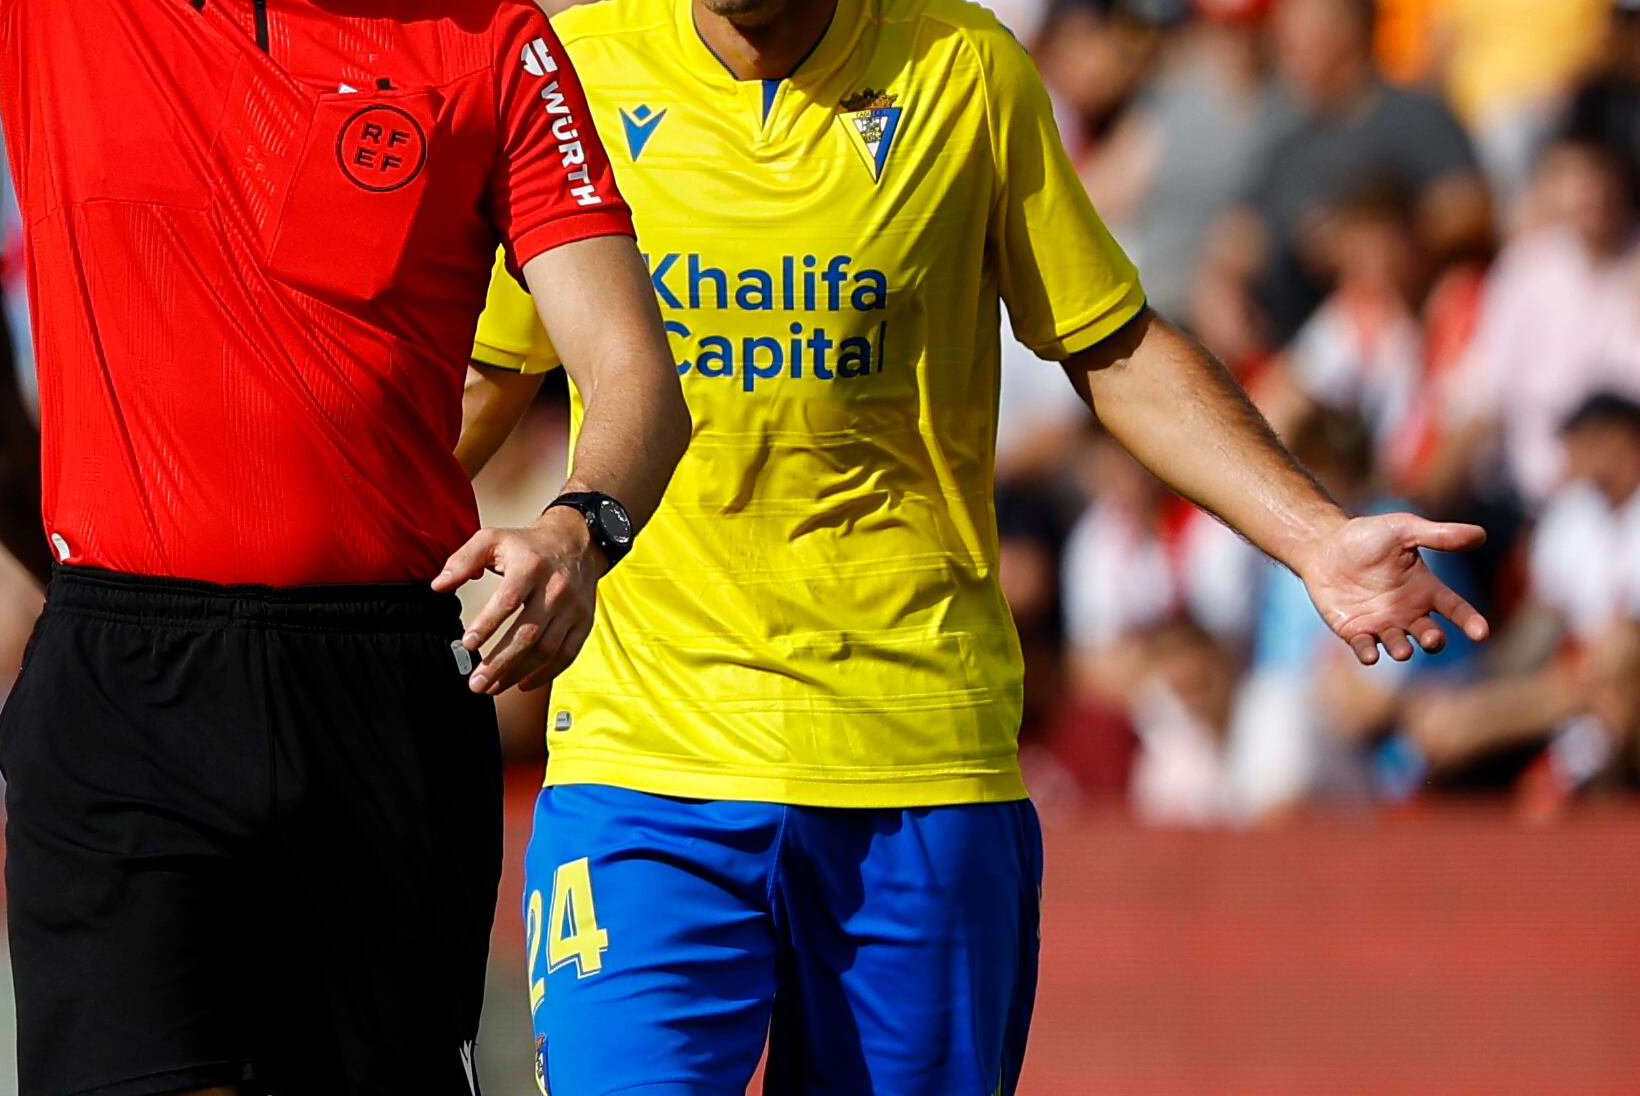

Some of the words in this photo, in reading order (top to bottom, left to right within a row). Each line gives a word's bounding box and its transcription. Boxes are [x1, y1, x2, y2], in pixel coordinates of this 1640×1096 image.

[541, 80, 602, 206] WÜRTH
[638, 253, 888, 311] Khalifa
[527, 856, 609, 1017] 24
